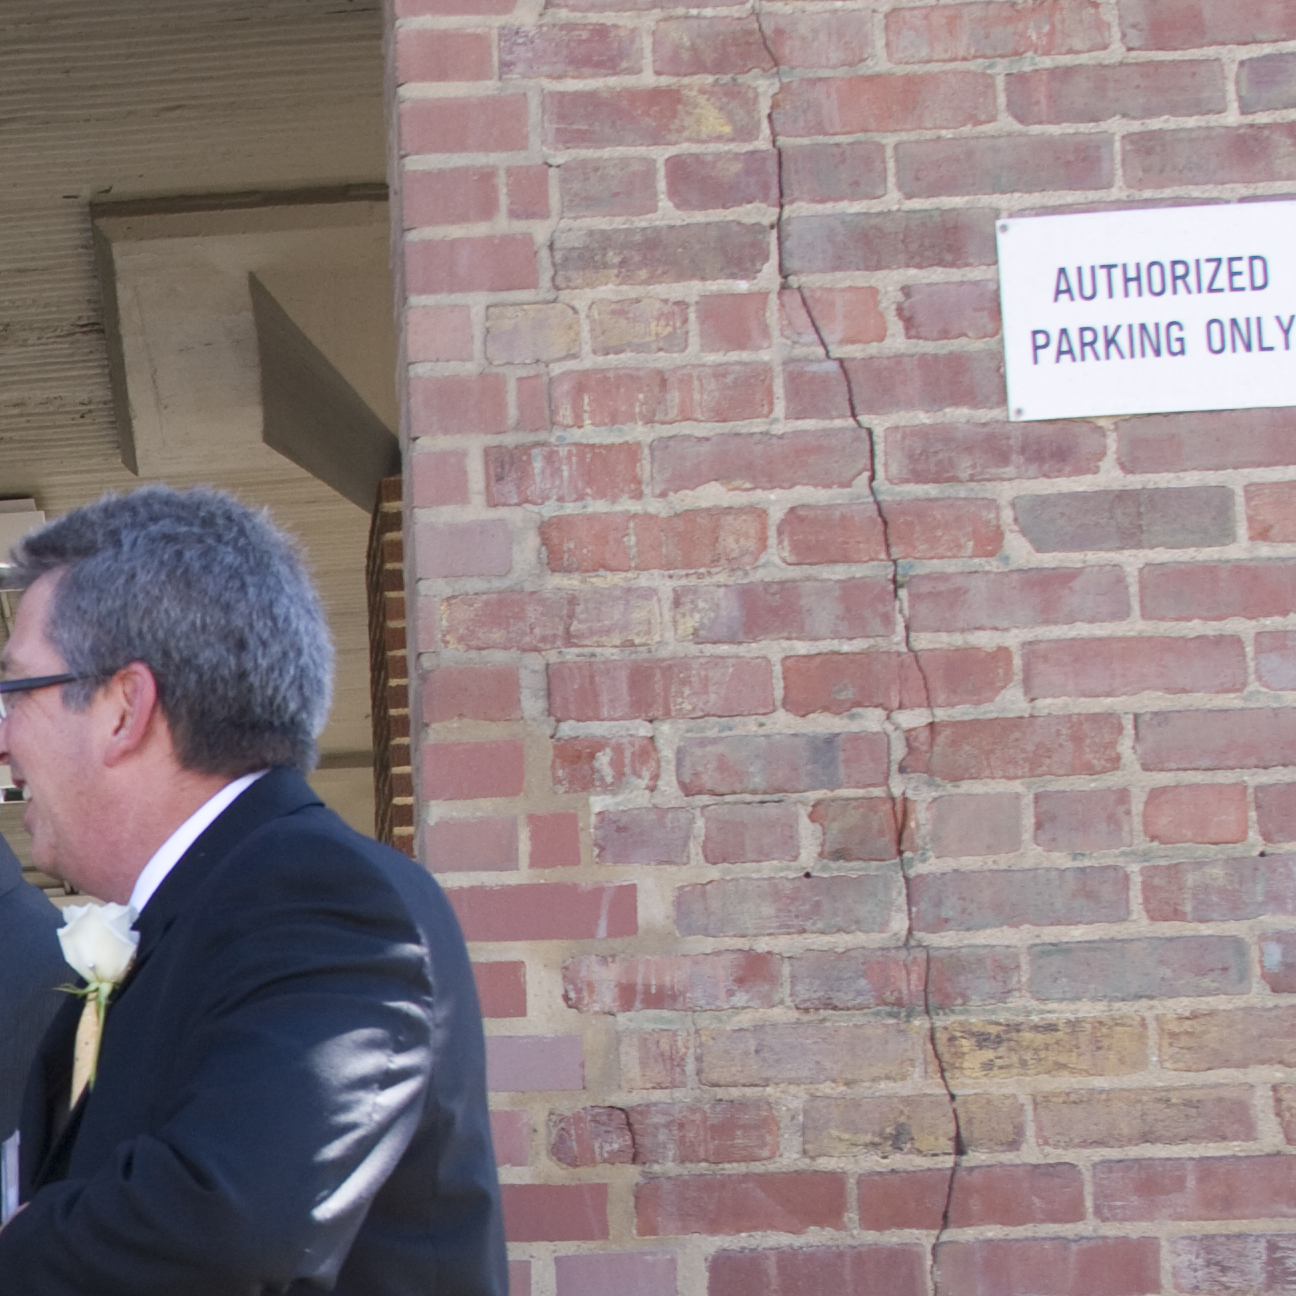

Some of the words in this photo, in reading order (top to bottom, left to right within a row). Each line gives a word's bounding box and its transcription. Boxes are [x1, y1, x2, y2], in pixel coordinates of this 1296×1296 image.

[1053, 255, 1269, 303] AUTHORIZED
[1030, 320, 1186, 366] PARKING
[1205, 314, 1296, 356] ONLY
